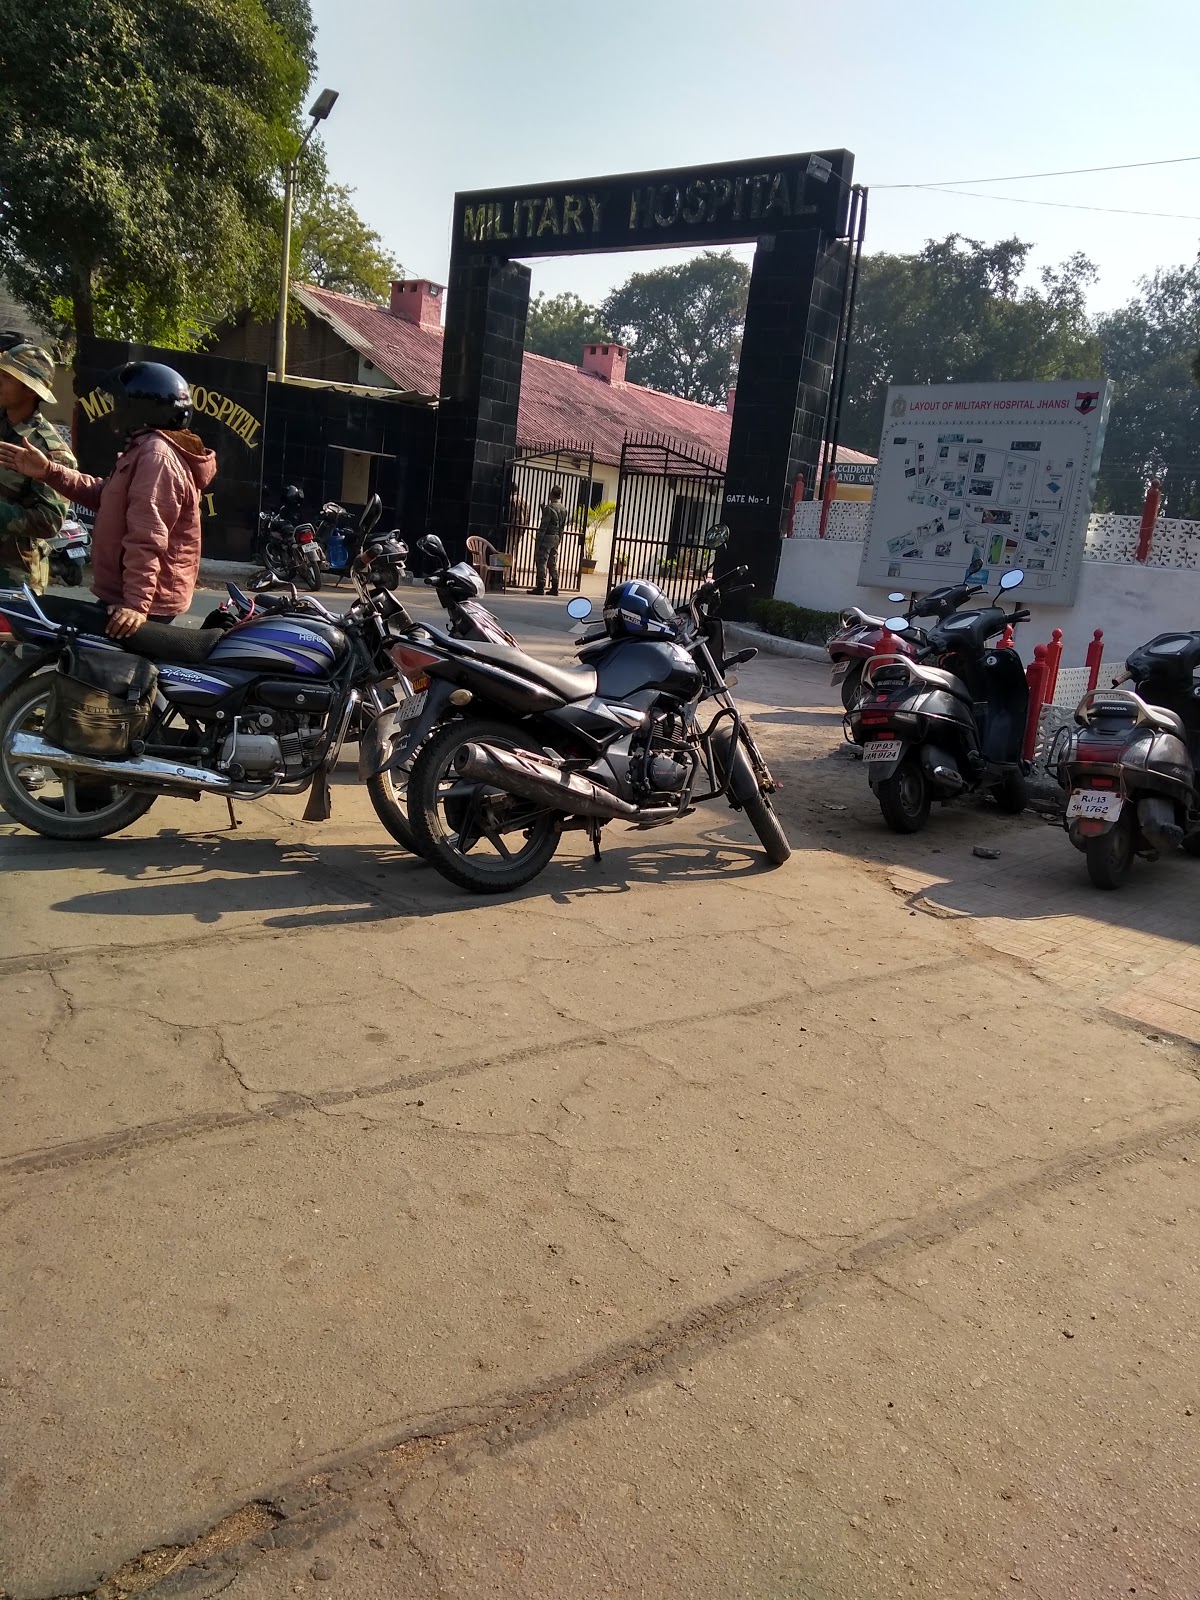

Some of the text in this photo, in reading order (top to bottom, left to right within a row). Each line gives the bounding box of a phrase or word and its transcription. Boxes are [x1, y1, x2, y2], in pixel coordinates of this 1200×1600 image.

[463, 172, 817, 242] MILITARY HOSPITAL
[909, 399, 1070, 411] LAYOUT OF MILITARY HOSPITAL JHANSI
[837, 473, 855, 482] AND
[726, 494, 746, 503] GATE
[298, 632, 325, 644] Hero
[1085, 805, 1109, 814] 1762
